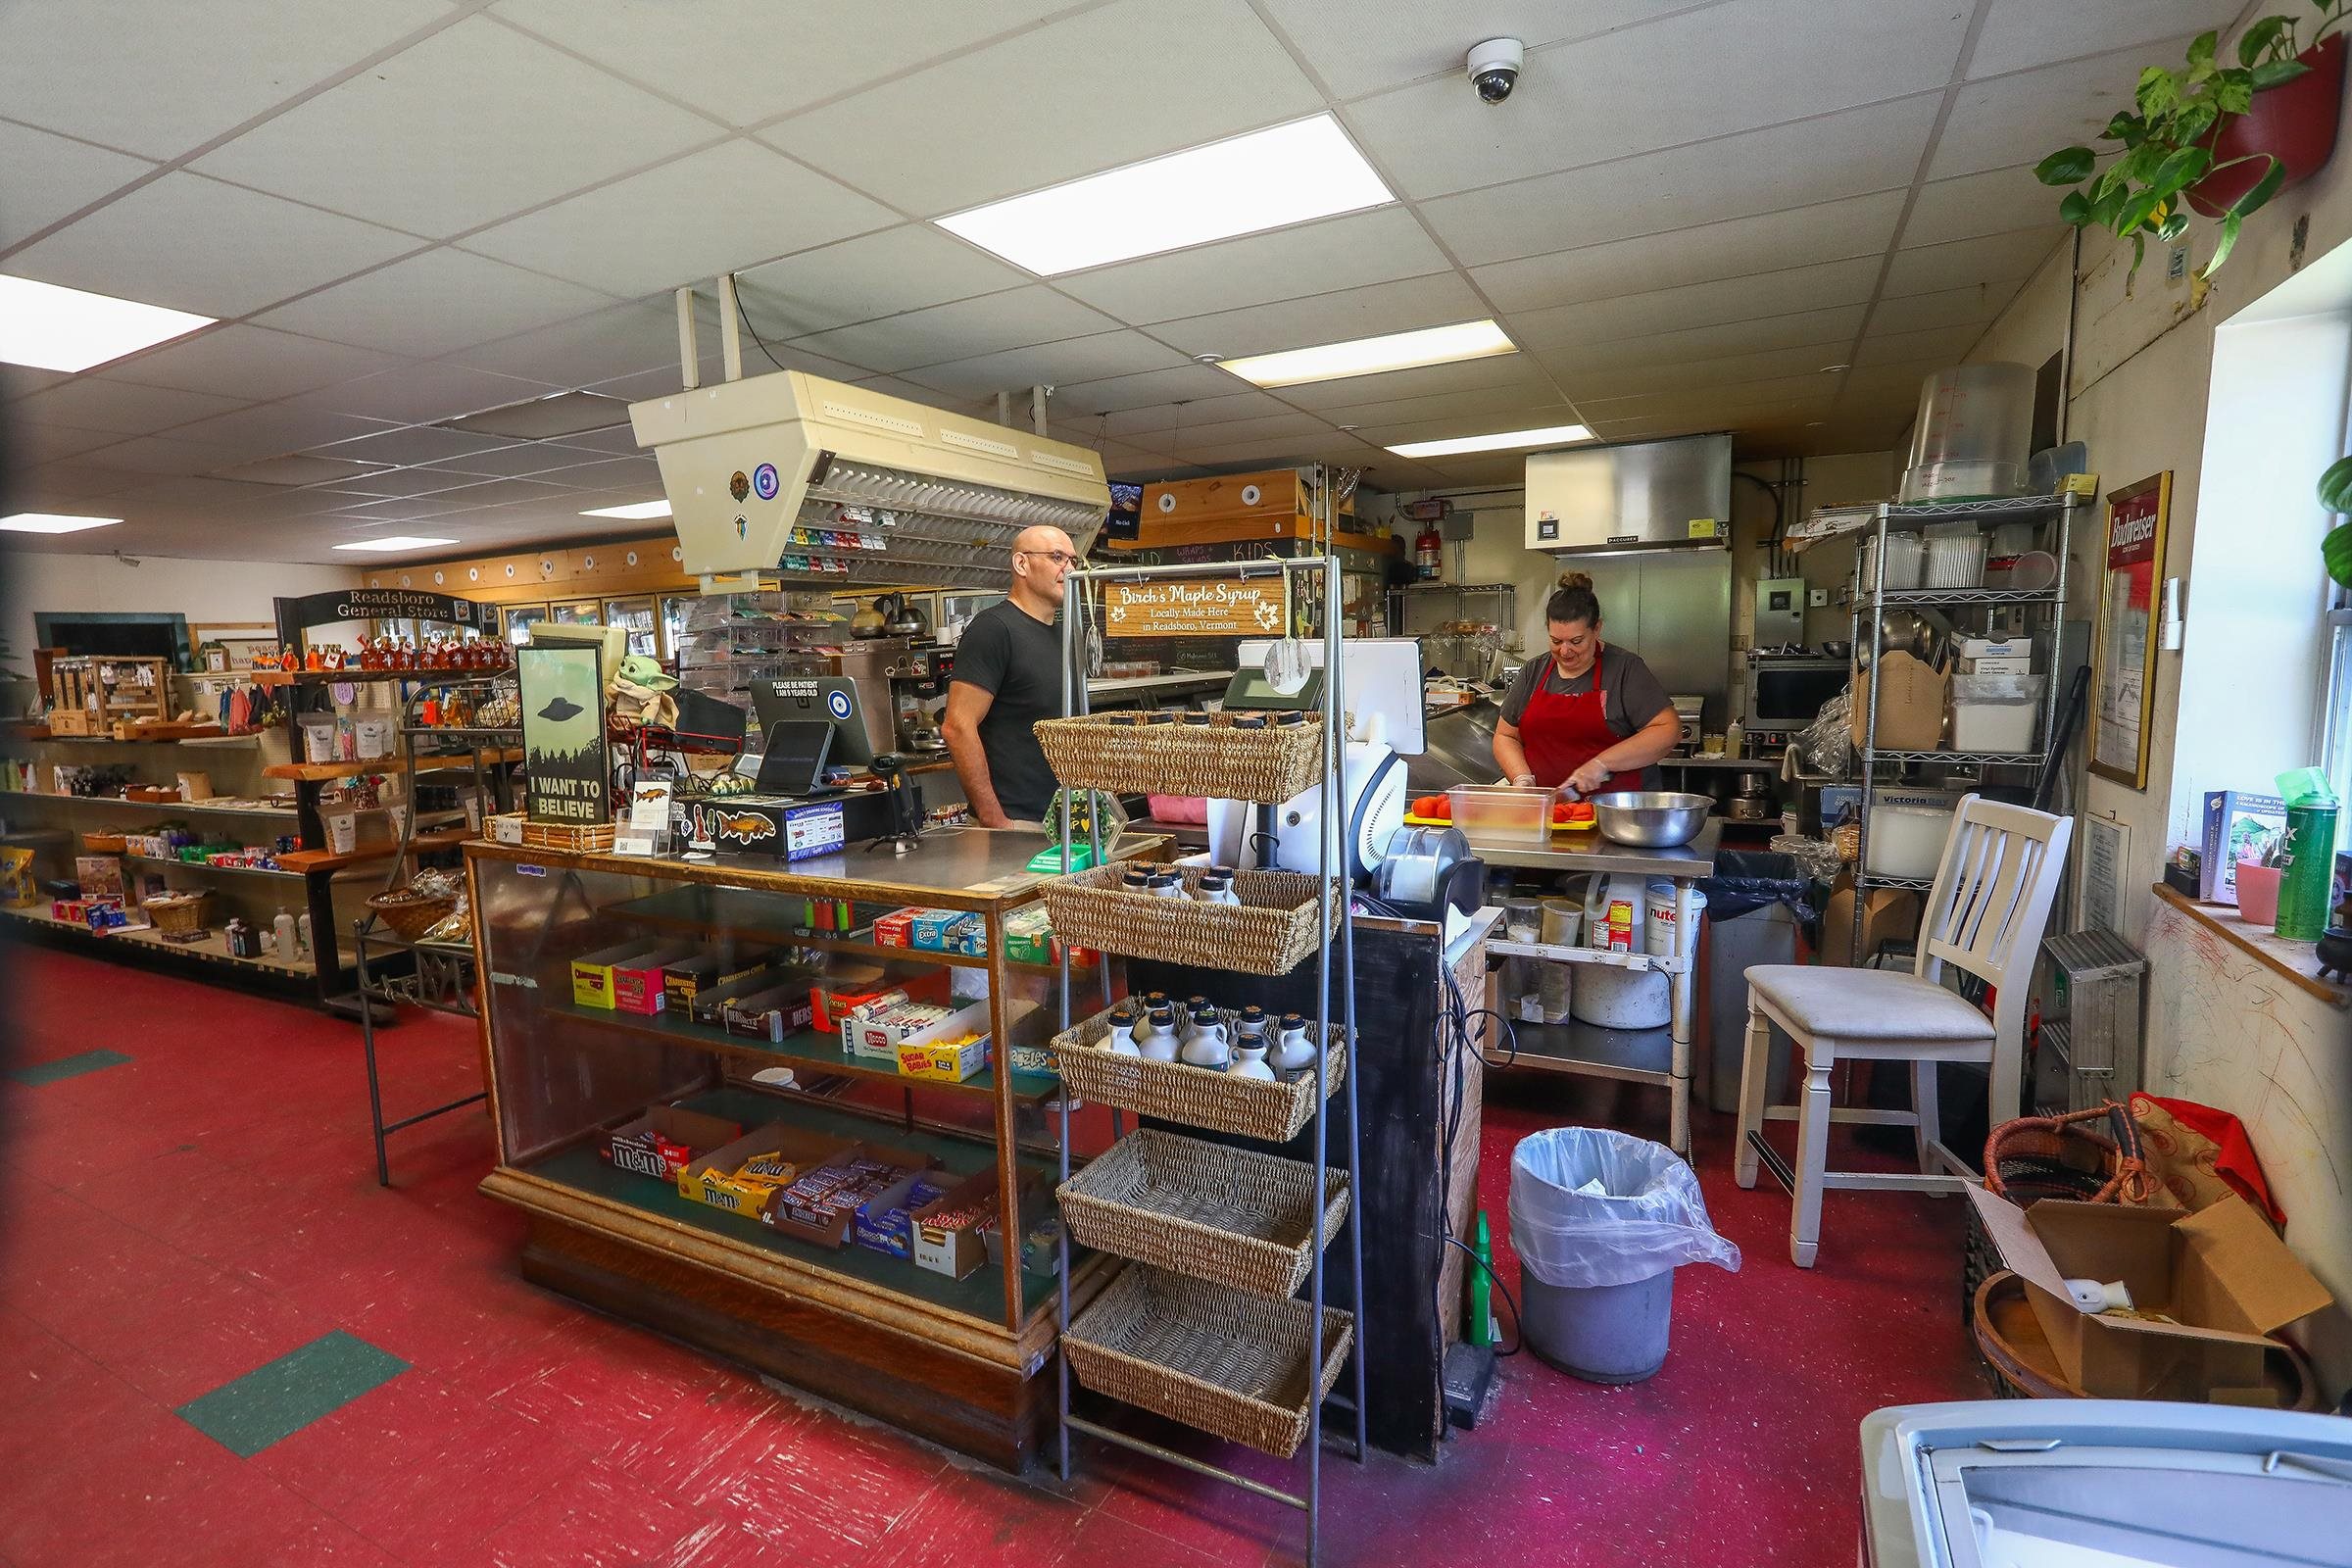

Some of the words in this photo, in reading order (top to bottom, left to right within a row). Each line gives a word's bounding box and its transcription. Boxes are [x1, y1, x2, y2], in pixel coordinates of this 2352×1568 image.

[2111, 508, 2156, 548] Budweiser
[1233, 541, 1274, 562] KIDS
[350, 591, 434, 606] Readsboro
[1120, 587, 1166, 606] Birch's
[1169, 585, 1214, 608] Maple
[1215, 584, 1261, 608] Syrup
[337, 604, 402, 618] General
[408, 604, 448, 618] Store
[1151, 608, 1179, 618] Locally
[1182, 608, 1205, 617] Made
[1207, 607, 1229, 616] Here
[1143, 621, 1151, 630] in
[1152, 621, 1198, 631] Readsboro,
[1200, 620, 1237, 630] Vermont
[798, 680, 818, 689] PATIENT
[530, 776, 536, 793] I
[538, 777, 578, 797] WANT
[581, 780, 601, 799] TO
[1884, 796, 1927, 805] Victoria
[2236, 795, 2253, 804] LOVE
[538, 798, 595, 819] BELIEVE
[1650, 907, 1676, 922] nute
[918, 930, 936, 940] Extra
[793, 1005, 812, 1026] HERS
[866, 1031, 887, 1046] Necco
[901, 1052, 925, 1063] SUGAR
[906, 1060, 932, 1074] BABIES
